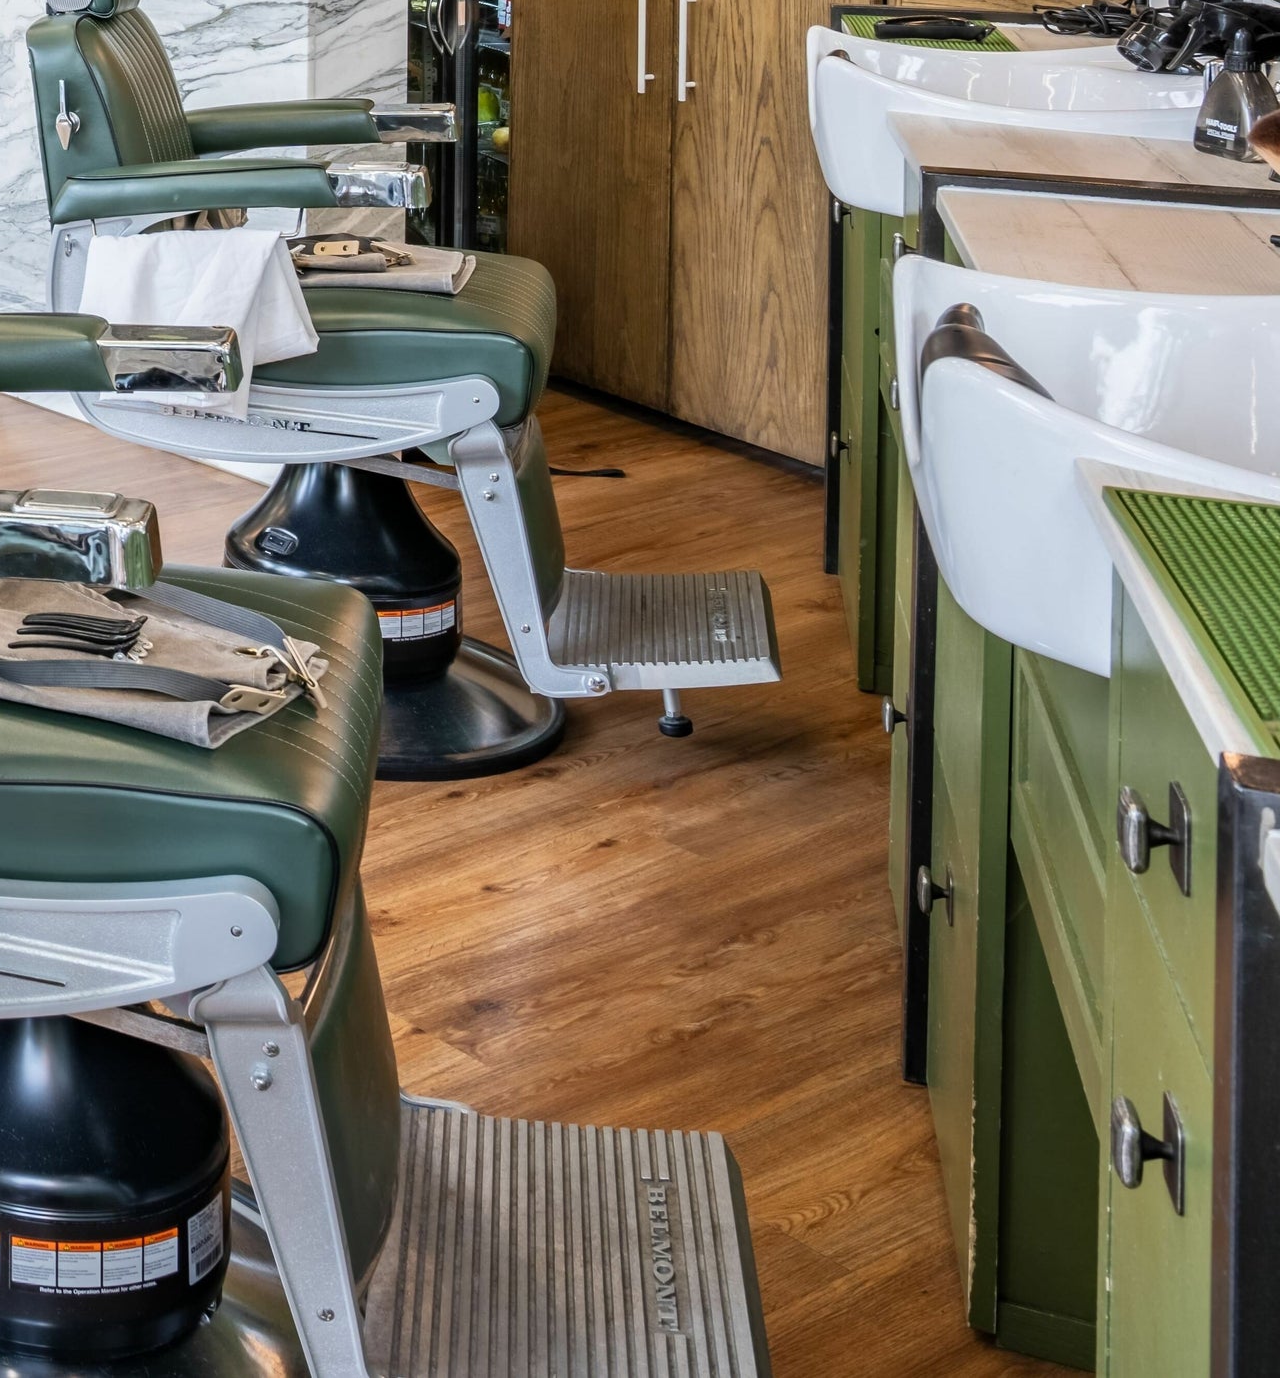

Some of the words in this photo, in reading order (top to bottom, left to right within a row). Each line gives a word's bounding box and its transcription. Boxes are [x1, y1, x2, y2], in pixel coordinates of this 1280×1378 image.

[24, 1241, 49, 1249] WARNING
[646, 1184, 680, 1333] BELMONT
[73, 1288, 100, 1296] Operation
